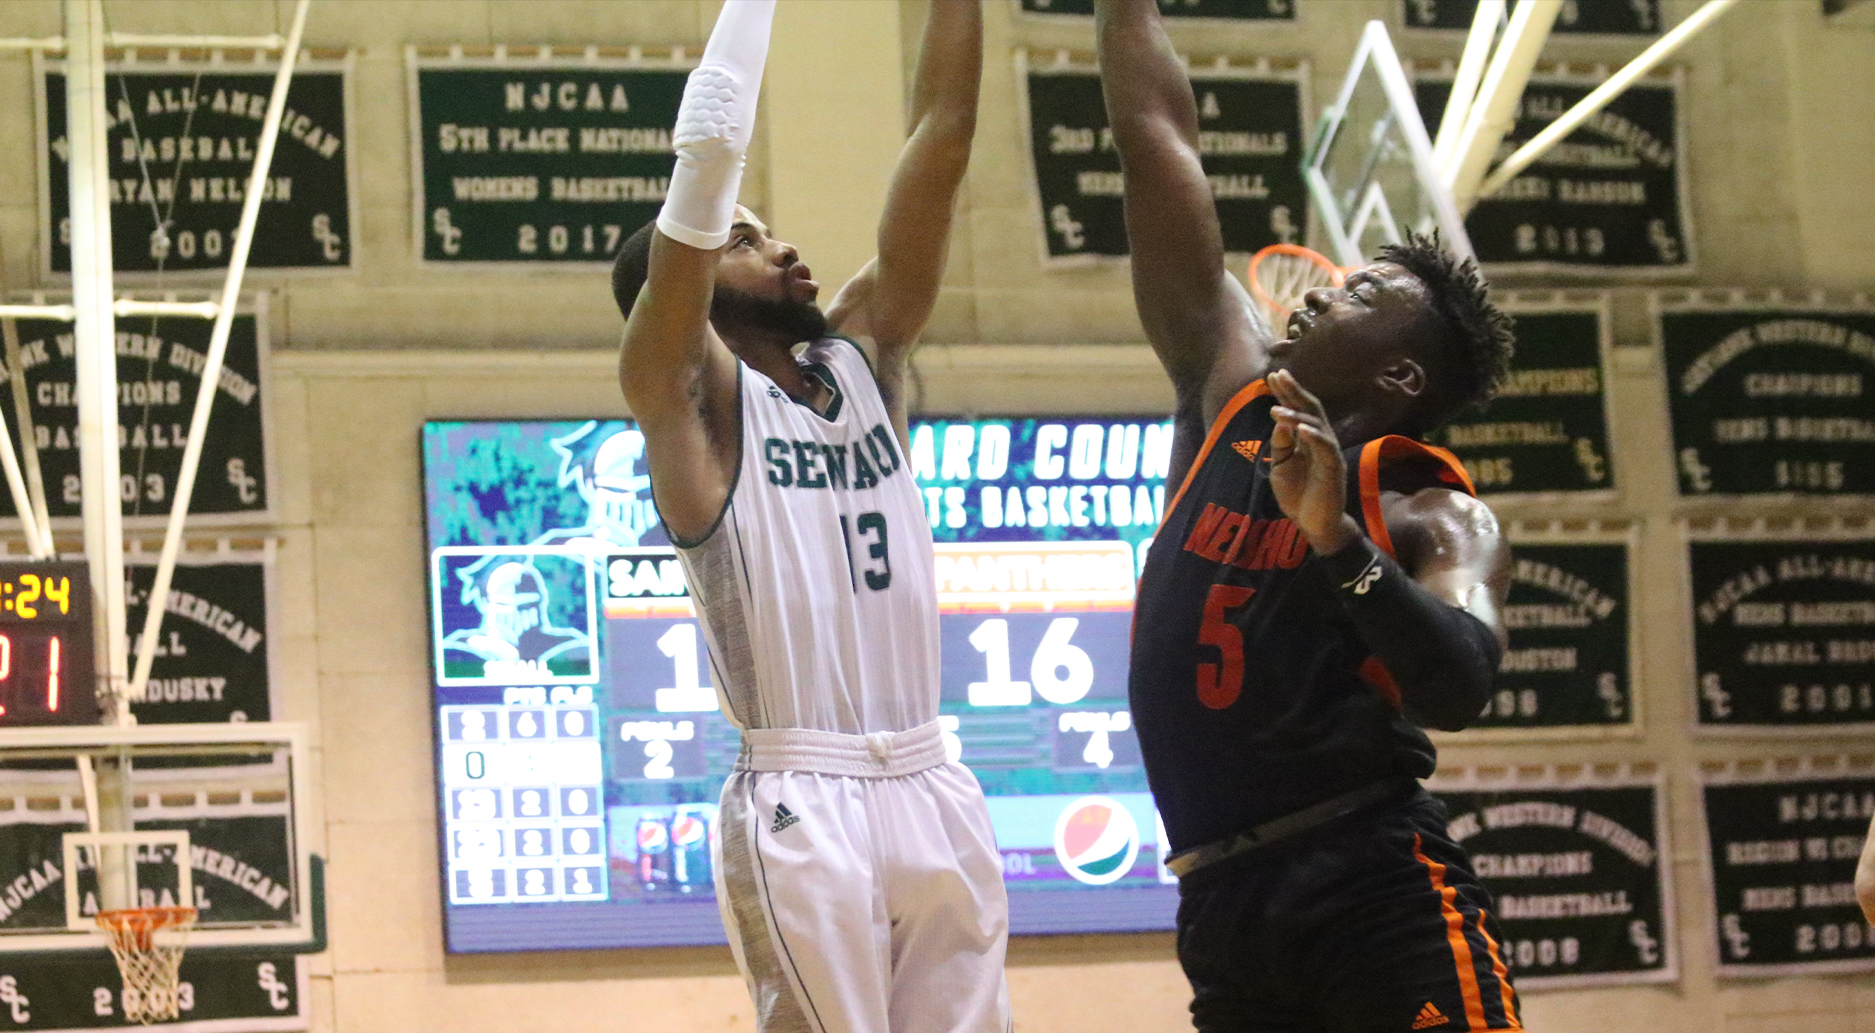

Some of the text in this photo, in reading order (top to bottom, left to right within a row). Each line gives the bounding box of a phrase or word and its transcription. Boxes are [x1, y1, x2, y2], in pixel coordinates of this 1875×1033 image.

[505, 82, 630, 112] NJCAA
[147, 87, 341, 159] ALL-AMEICAN
[440, 123, 675, 153] 5TH PLACE NATIONA
[121, 138, 260, 162] BASEBAL
[551, 176, 670, 201] BASKETBAL
[517, 224, 622, 253] 2017
[37, 381, 181, 406] CHIONS
[1033, 423, 1175, 480] COUN
[63, 473, 166, 503] 203
[0, 573, 70, 619] :24
[967, 617, 1095, 705] 16
[1196, 582, 1257, 710] 5
[643, 739, 675, 780] 2
